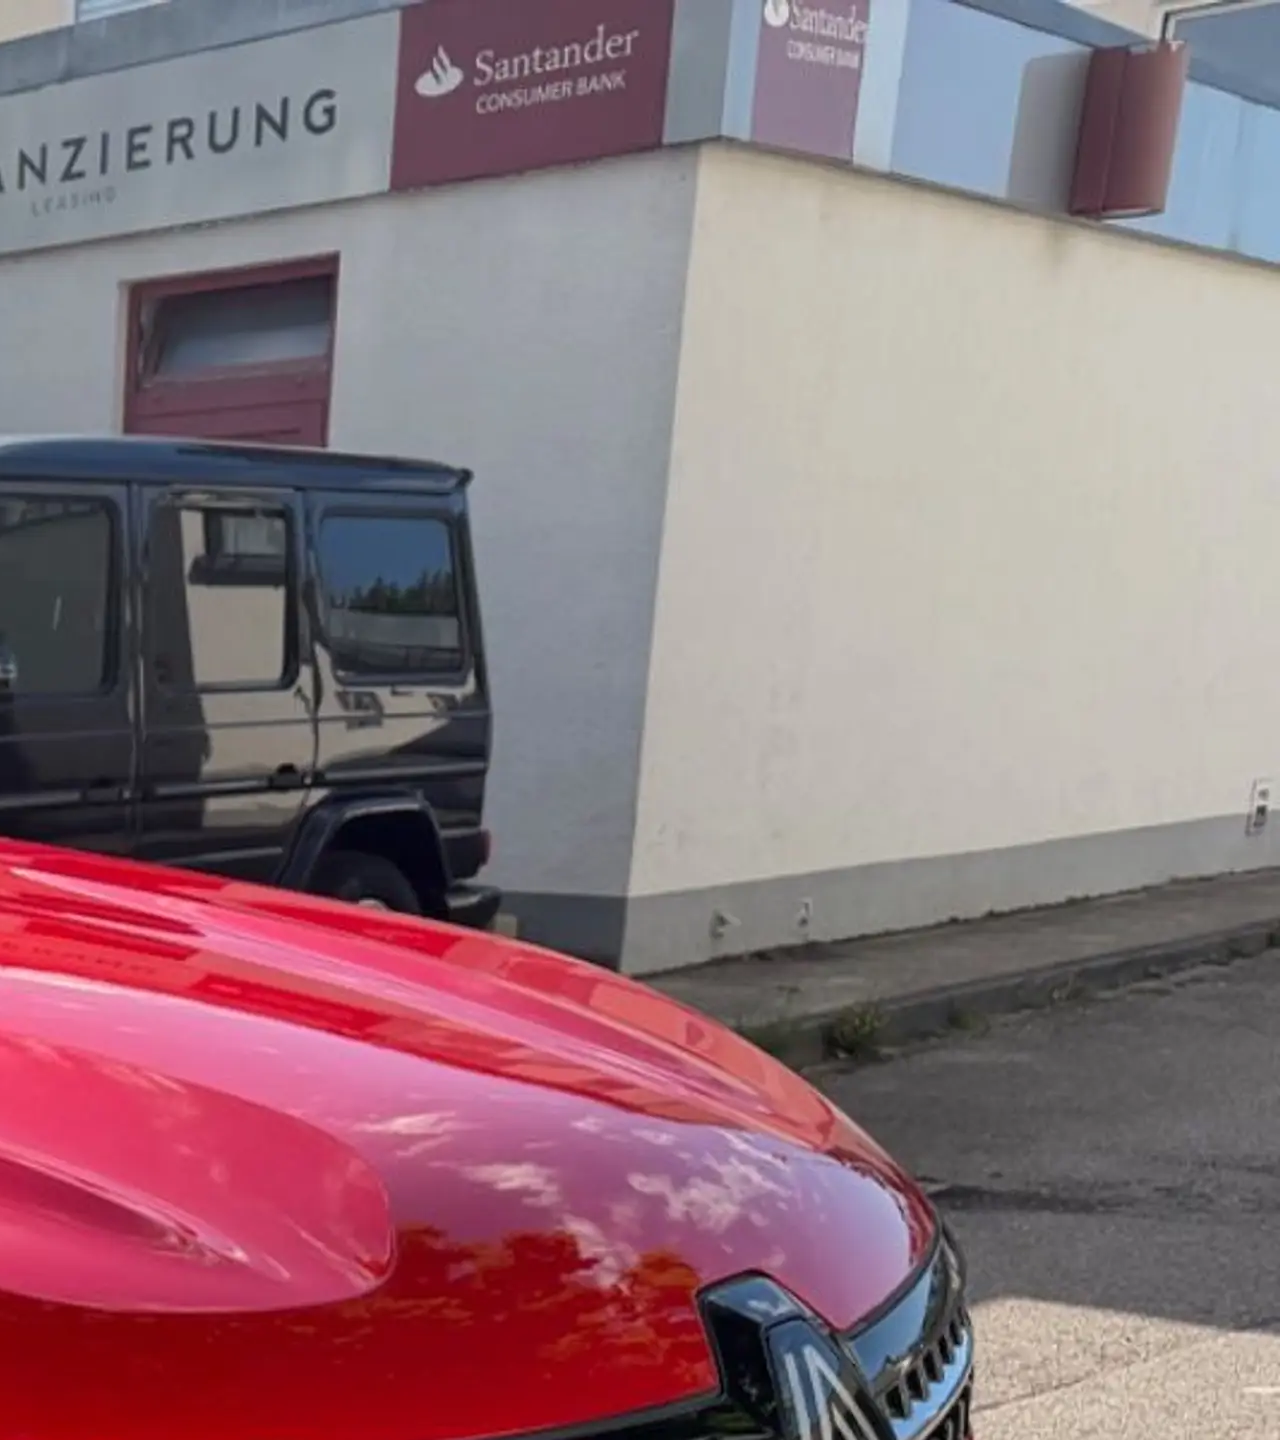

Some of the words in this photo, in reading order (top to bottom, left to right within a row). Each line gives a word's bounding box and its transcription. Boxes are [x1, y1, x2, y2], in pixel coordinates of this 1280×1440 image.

[473, 24, 639, 86] Santander
[476, 79, 573, 114] CONSUMER
[576, 69, 627, 96] BANK
